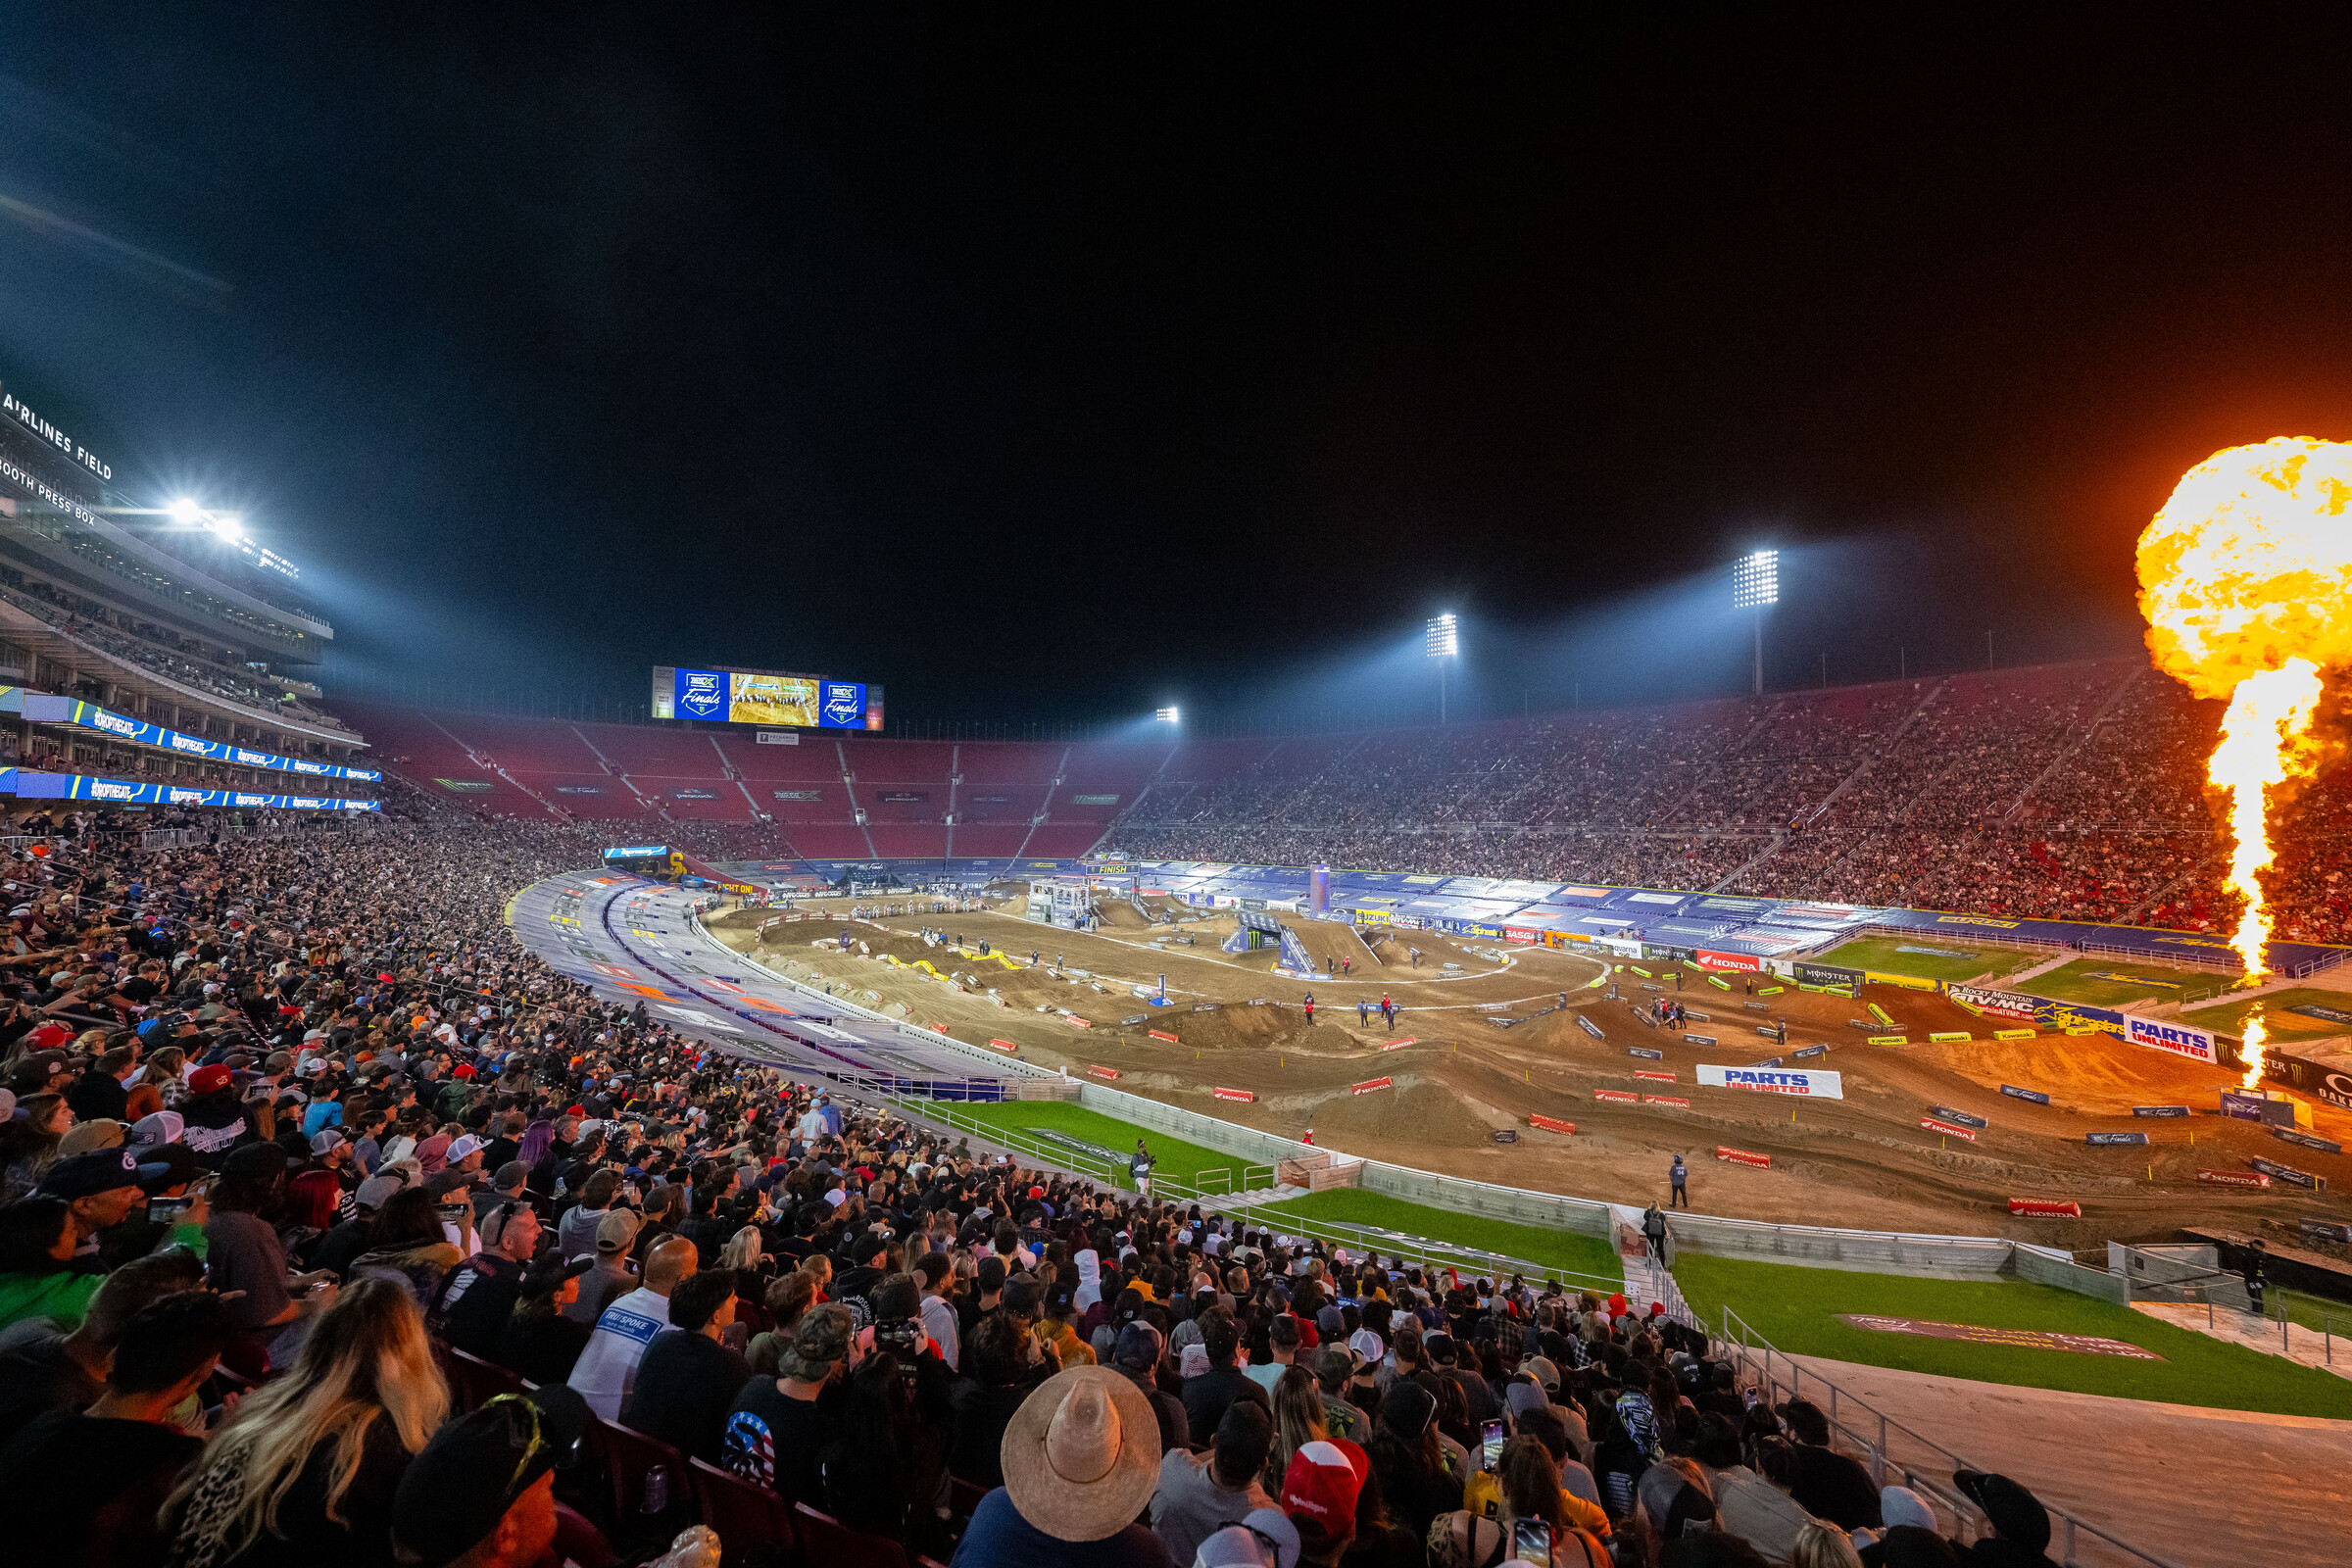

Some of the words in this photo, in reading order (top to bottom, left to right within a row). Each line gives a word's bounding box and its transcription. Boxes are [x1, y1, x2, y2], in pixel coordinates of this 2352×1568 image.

[3, 393, 72, 453] AIRLINES
[77, 445, 112, 480] FIELD
[38, 484, 72, 513] PRESS
[74, 507, 95, 527] BOX
[681, 688, 720, 704] Finals
[824, 699, 858, 713] Finals
[94, 711, 134, 735] #DROPTHEGATE
[172, 735, 205, 753] #DROPTHEGATE
[91, 782, 131, 799] #DROPTHEGATE
[740, 885, 753, 894] ON!
[1357, 913, 1389, 922] SUZUKI
[1712, 958, 1758, 972] HONDA
[1805, 970, 1851, 983] MONSTER
[1962, 986, 1990, 997] ROCKY
[1991, 992, 2034, 1004] MOUNTAIN
[2131, 1020, 2208, 1050] PARTS
[1390, 1040, 1414, 1050] HONDA
[2132, 1033, 2209, 1058] UNLIMITED
[1725, 1070, 1809, 1086] PARTS
[1361, 1083, 1391, 1095] HONDA
[1726, 1082, 1810, 1095] UNLIMITED
[1604, 1095, 1637, 1103] HONDA
[2019, 1091, 2037, 1100] Finals
[1655, 1100, 1689, 1108] HONDA
[1953, 1114, 1974, 1124] Finals
[1540, 1124, 1573, 1137] HONDA
[1932, 1124, 1970, 1140] HONDA
[2110, 1134, 2132, 1143] Finals
[1729, 1157, 1769, 1169] HONDA
[2211, 1174, 2260, 1186] HONDA
[2026, 1210, 2078, 1219] HONDA
[619, 1314, 650, 1331] SPOKE
